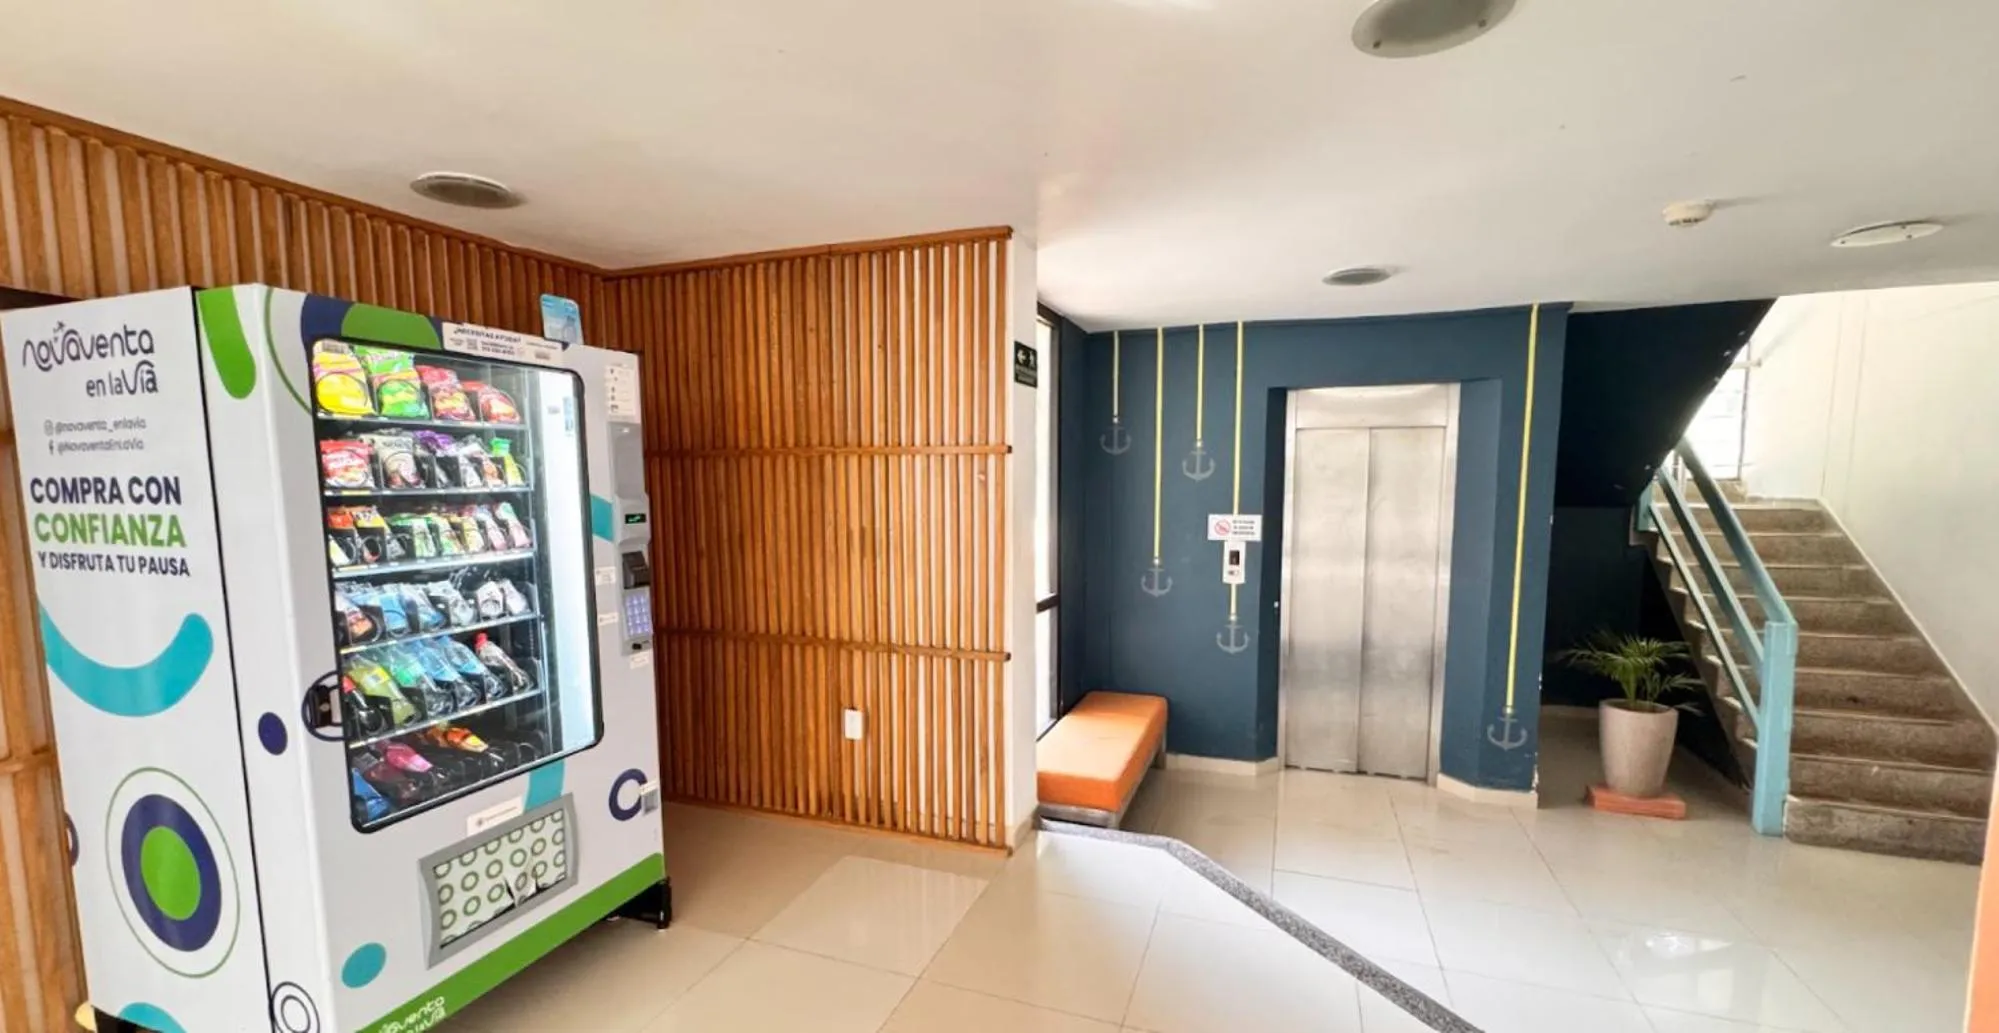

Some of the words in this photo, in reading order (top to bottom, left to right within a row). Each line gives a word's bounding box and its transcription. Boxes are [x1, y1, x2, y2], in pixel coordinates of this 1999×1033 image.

[22, 324, 155, 372] novaventa
[86, 379, 106, 398] en
[30, 476, 124, 504] COMPRA
[128, 476, 182, 505] CON
[34, 512, 187, 548] CONFIANZA
[38, 551, 47, 568] Y
[50, 552, 114, 572] DISFRUTA
[116, 554, 136, 573] TU
[138, 555, 191, 577] PAUSA
